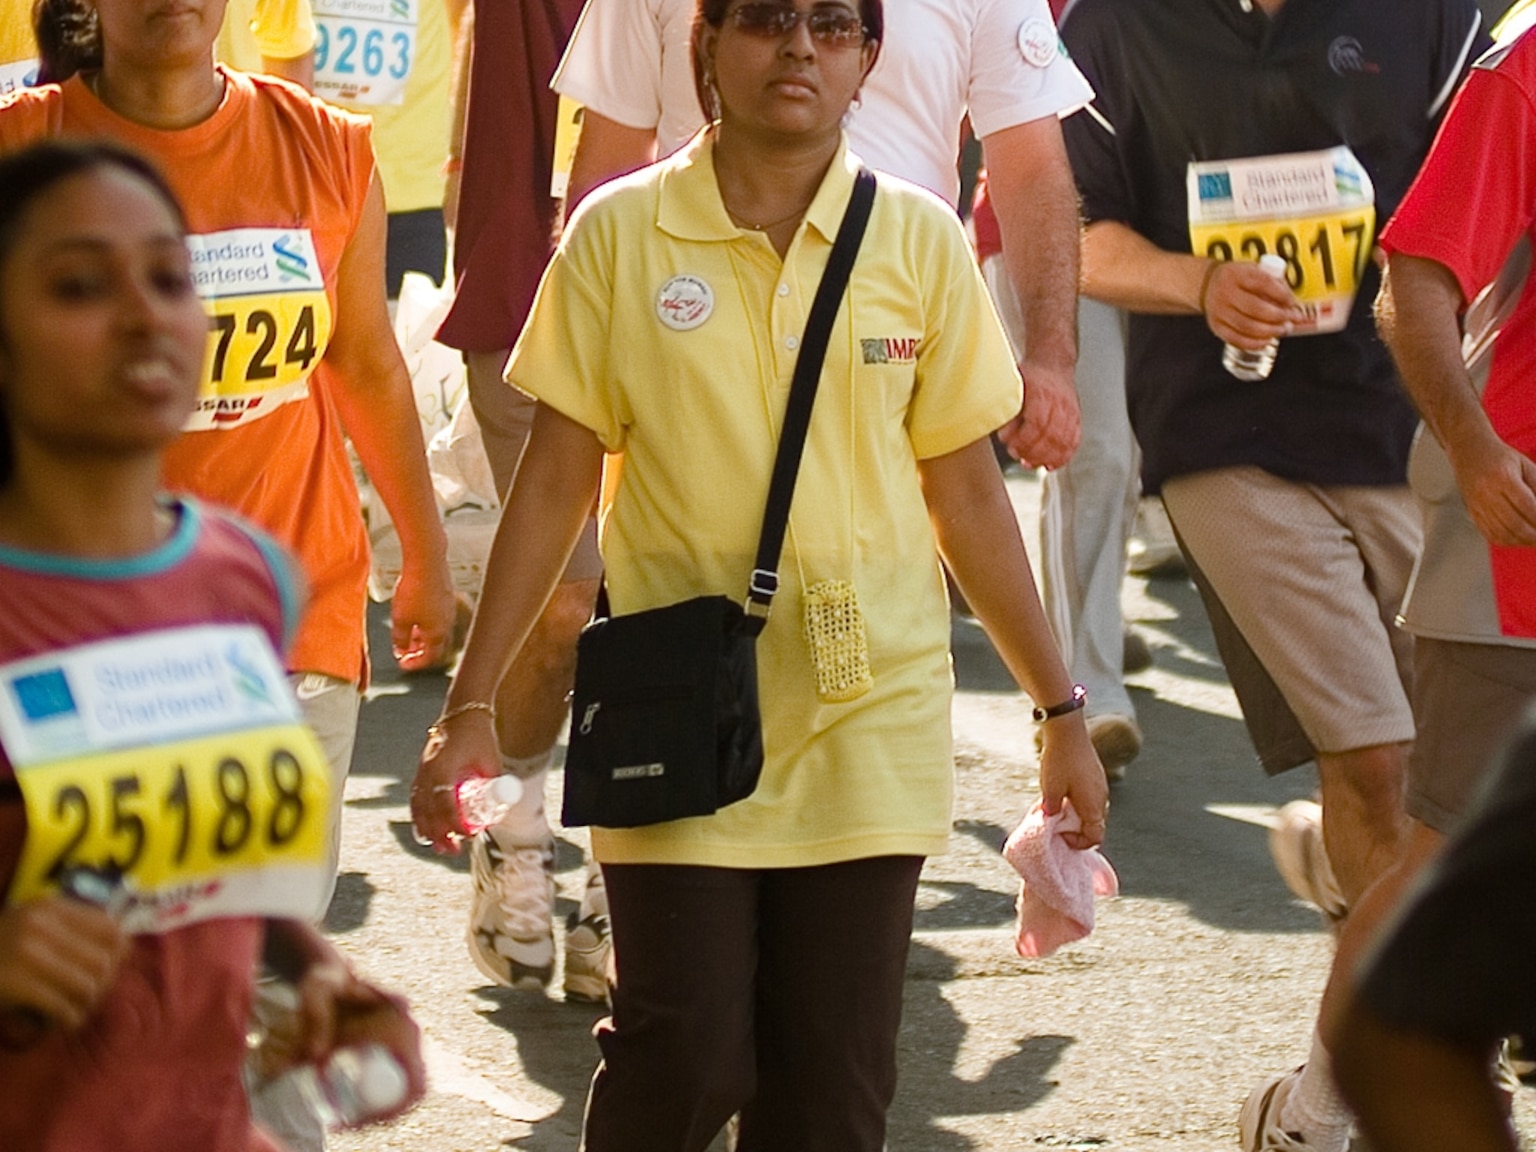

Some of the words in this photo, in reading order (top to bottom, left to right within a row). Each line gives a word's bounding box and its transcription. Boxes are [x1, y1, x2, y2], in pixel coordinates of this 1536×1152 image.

[1246, 162, 1326, 190] Standard
[189, 241, 265, 263] tandard
[191, 264, 269, 286] hartered
[208, 306, 317, 382] 724
[197, 398, 246, 411] SAR
[96, 654, 217, 693] Standard
[42, 749, 305, 883] 25188
